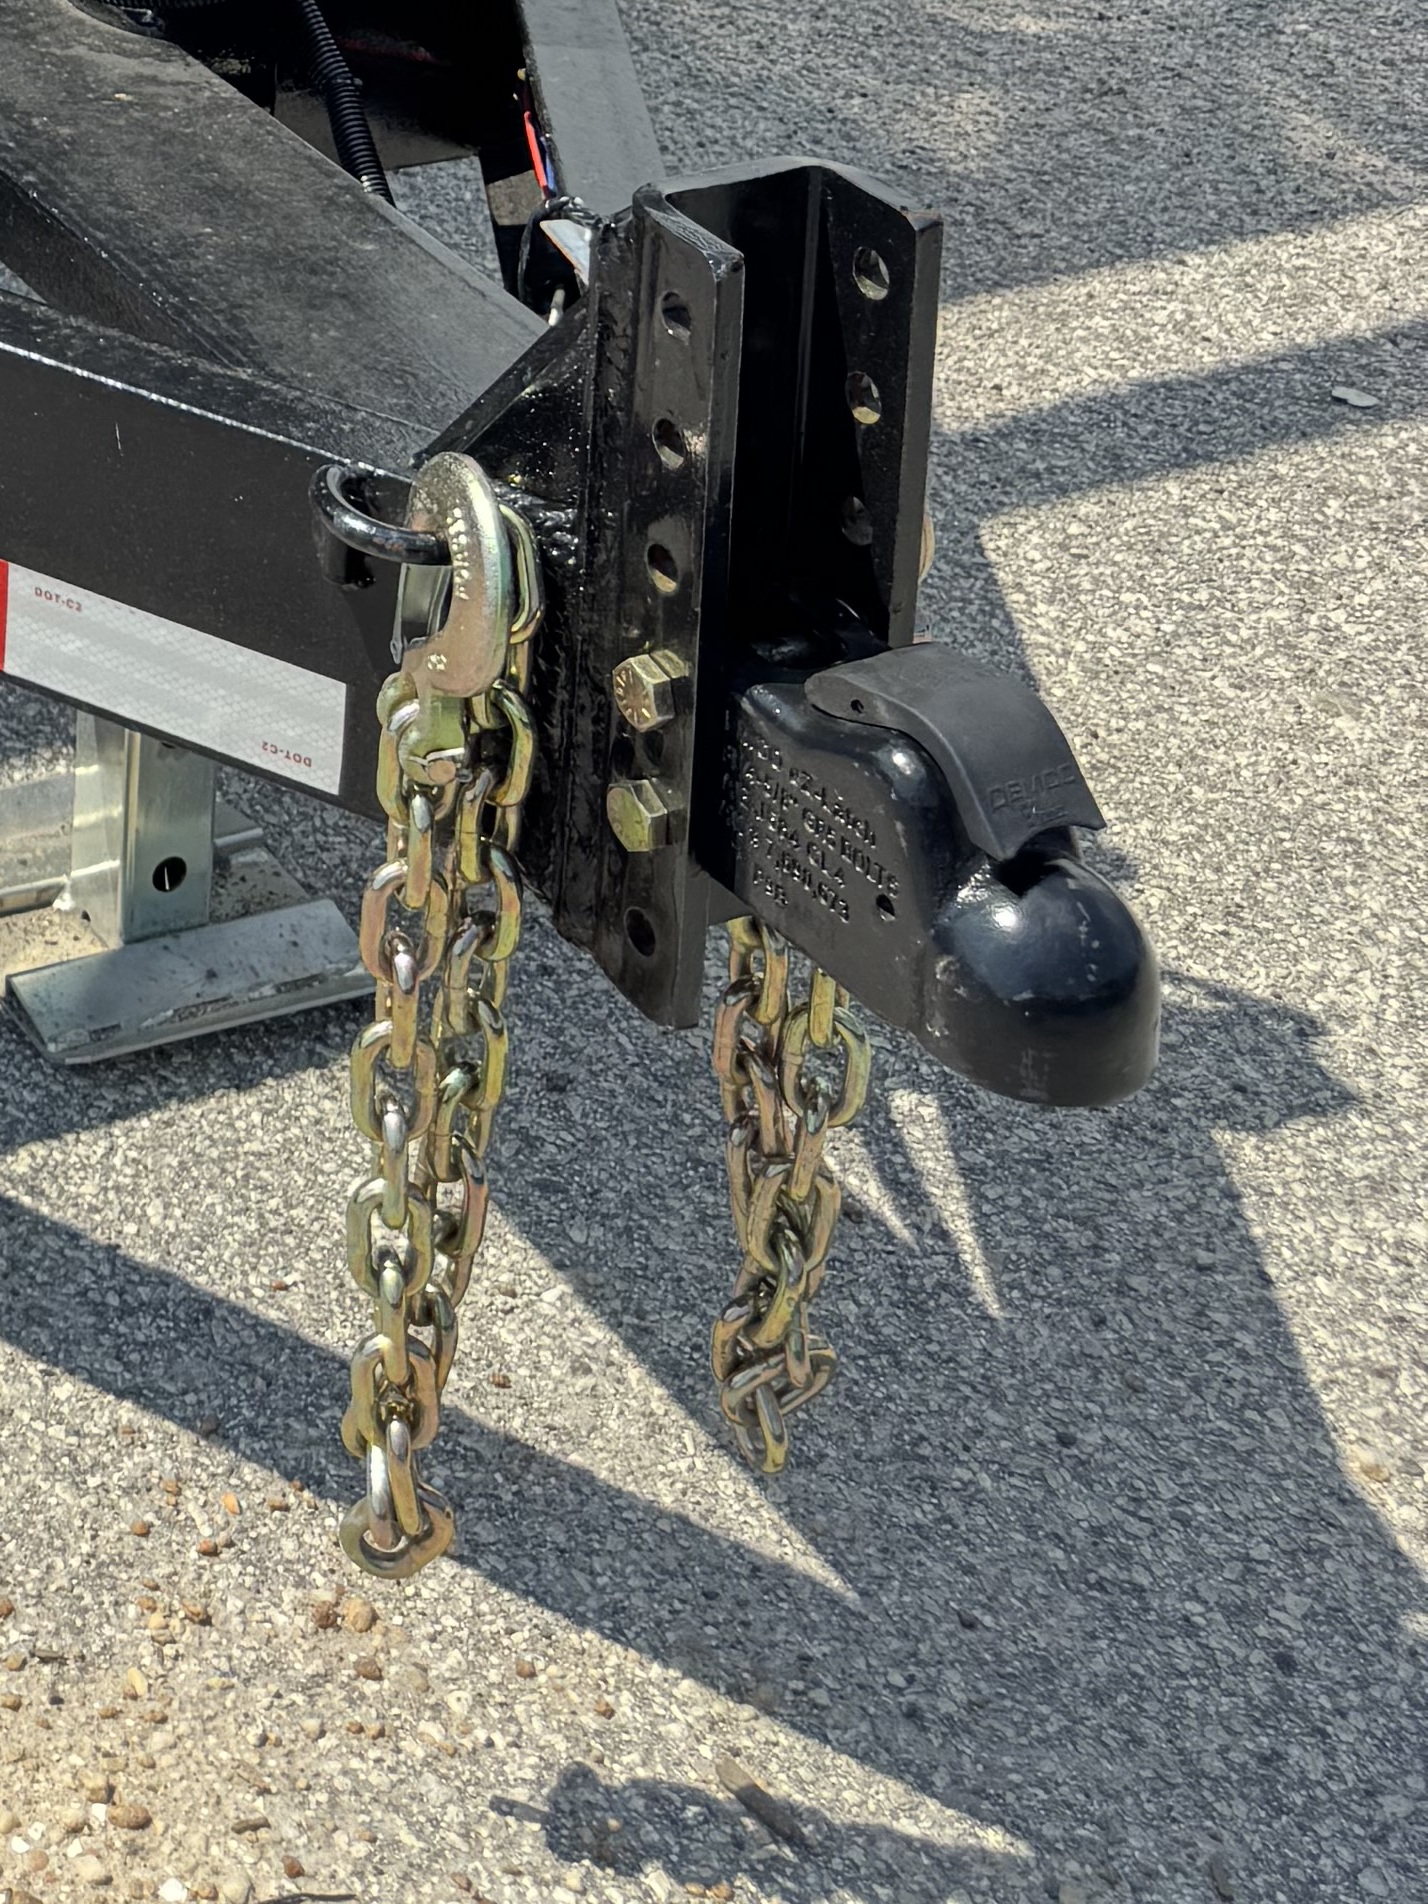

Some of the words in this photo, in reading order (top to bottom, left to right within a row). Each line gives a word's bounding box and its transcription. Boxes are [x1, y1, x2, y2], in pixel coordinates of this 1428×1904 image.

[34, 586, 82, 613] DOT-C2
[261, 740, 312, 769] DOT-C2
[840, 835, 900, 900] BOLTS
